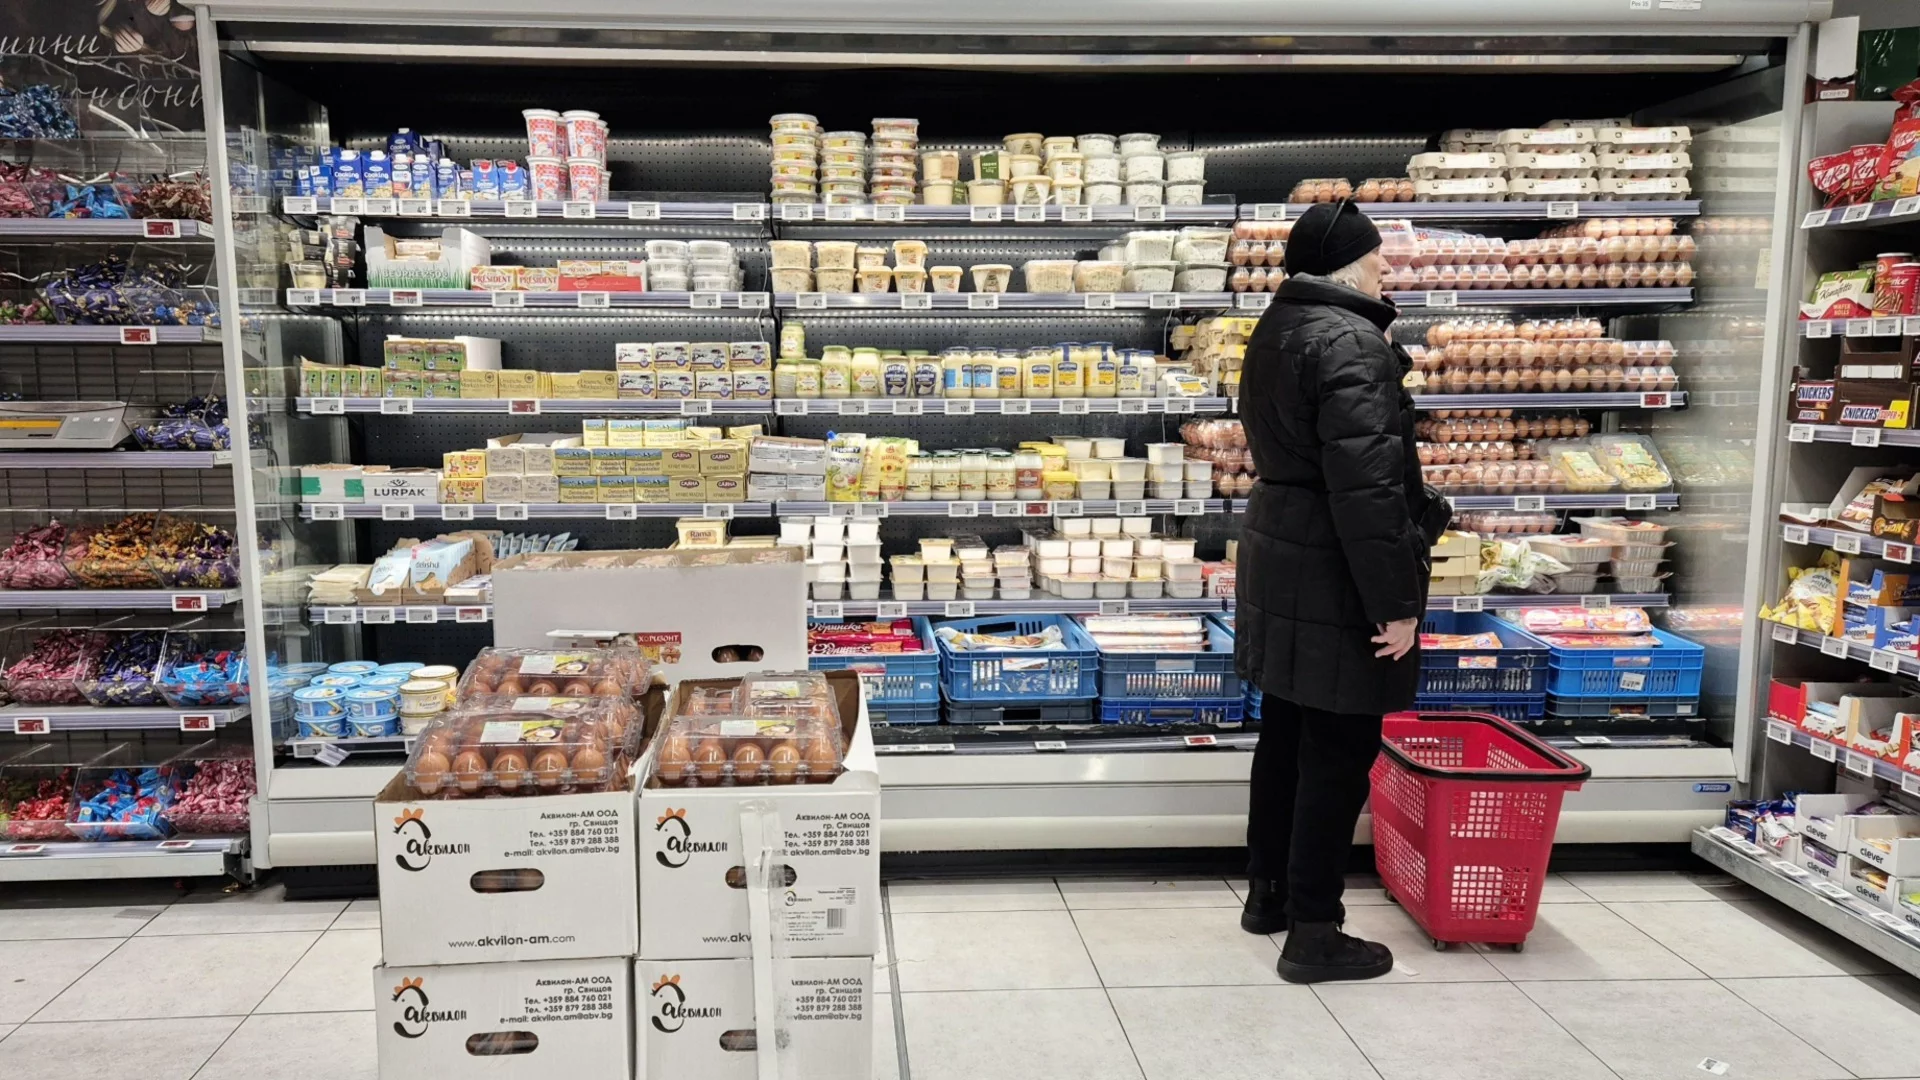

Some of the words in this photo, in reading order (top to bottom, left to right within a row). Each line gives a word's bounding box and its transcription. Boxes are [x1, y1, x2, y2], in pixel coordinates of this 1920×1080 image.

[334, 171, 360, 179] Cooking
[363, 171, 389, 180] Cooking
[1815, 164, 1850, 188] KitKat
[1797, 387, 1834, 400] SNICKERS
[1842, 408, 1879, 420] SNICKERS
[373, 487, 426, 497] LURPAK
[597, 809, 618, 818] ООД
[850, 812, 870, 820] ООД
[569, 820, 580, 828] гр.
[583, 818, 618, 827] Свищов
[836, 822, 870, 830] Свищов
[529, 830, 545, 839] Тел.
[548, 829, 568, 837] +359
[570, 828, 585, 836] 884
[587, 828, 601, 836] 760
[604, 827, 618, 835] 021
[823, 830, 838, 838] 884
[839, 830, 854, 838] 760
[856, 830, 870, 838] 021
[1805, 824, 1828, 841] clever
[549, 838, 569, 846] +359
[571, 838, 586, 846] 879
[587, 837, 602, 845] 288
[604, 836, 619, 844] 388
[784, 840, 800, 848] Тел.
[504, 848, 534, 858] e-mail:
[1859, 847, 1884, 865] clever
[1807, 861, 1830, 878] clever
[1855, 884, 1881, 903] clever
[448, 933, 576, 948] www.akvilon-am.com
[591, 976, 612, 984] ООД
[842, 978, 863, 986] ООД
[564, 987, 575, 995] гр.
[578, 985, 612, 993] Свищов
[829, 986, 862, 994] Свищов
[524, 997, 540, 1005] Тел.
[543, 996, 563, 1004] +359
[564, 995, 579, 1003] 884
[581, 994, 595, 1002] 760
[598, 994, 612, 1002] 021
[525, 1006, 540, 1014] Тел.
[544, 1005, 563, 1013] +359
[565, 1004, 580, 1012] 879
[795, 1004, 814, 1012] +359
[816, 1004, 831, 1012] 879
[500, 1016, 529, 1024] e-mail:
[793, 1012, 862, 1021] vilon.am@abv.bg
